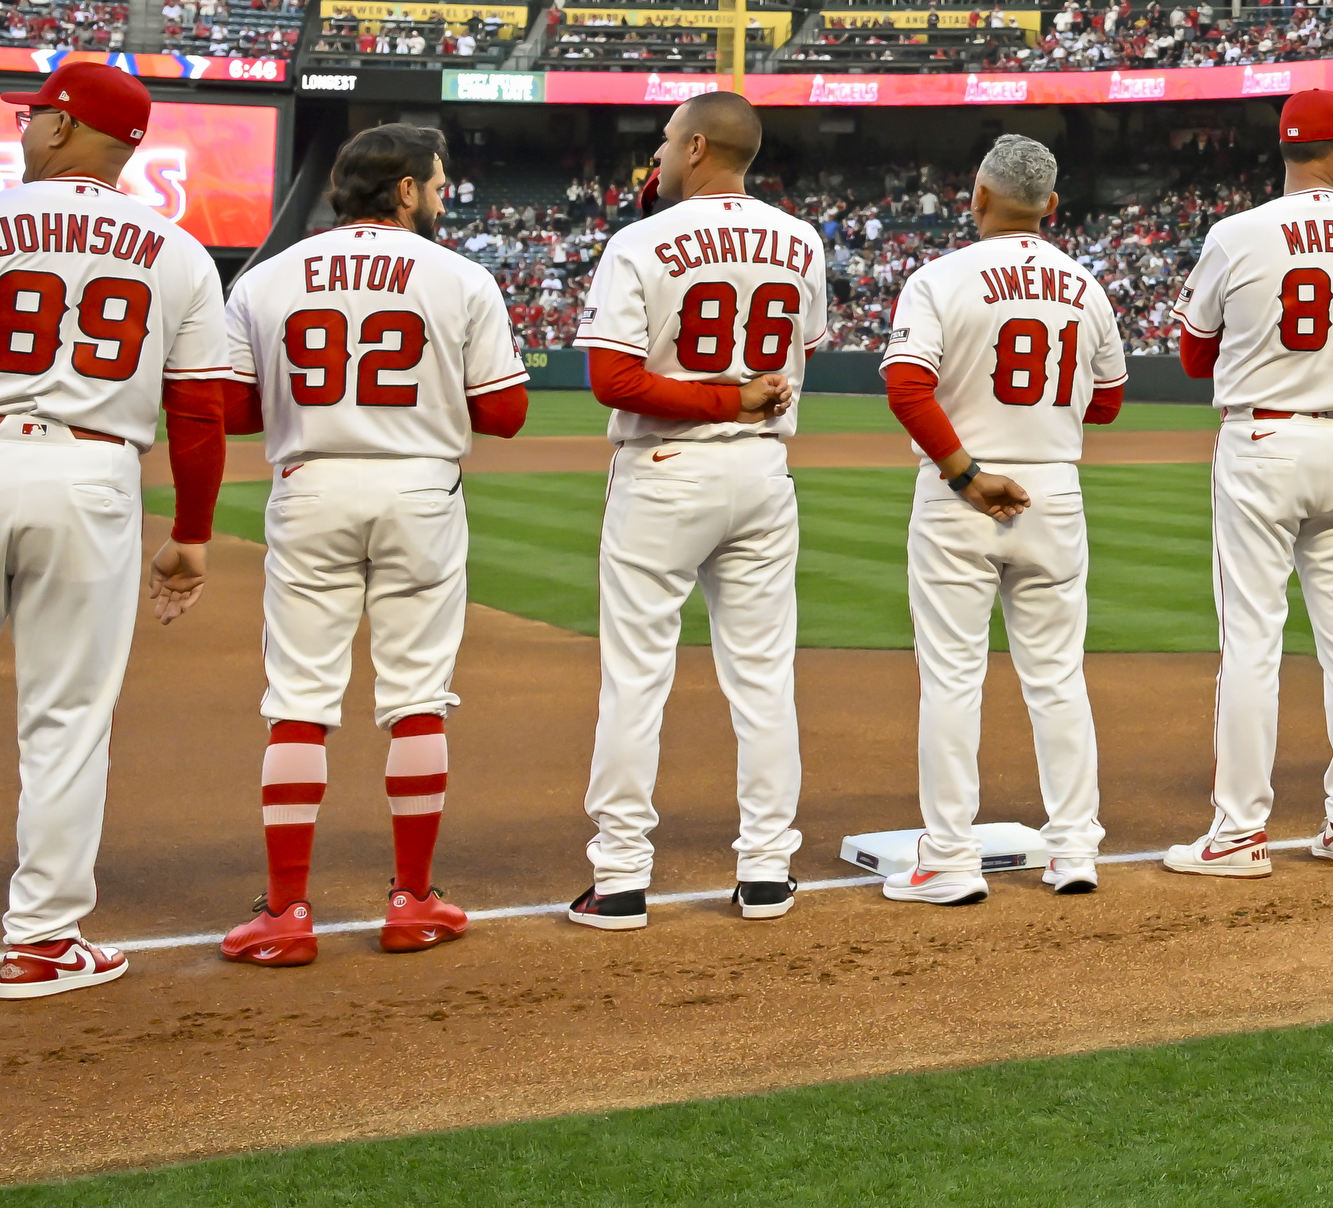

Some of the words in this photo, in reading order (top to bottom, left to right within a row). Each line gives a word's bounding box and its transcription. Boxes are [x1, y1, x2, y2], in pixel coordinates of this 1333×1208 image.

[302, 74, 357, 91] LONGEST
[810, 74, 878, 102] ANGELS
[965, 73, 1028, 101] ANGELS
[1108, 71, 1166, 100] ANGELS
[1242, 65, 1291, 94] ANGELS
[0, 212, 165, 269] JOHNSON
[655, 228, 814, 278] SCHATZLEY
[304, 255, 415, 294] EATON
[980, 256, 1087, 310] JIMÉNEZ
[0, 269, 152, 381] 89
[673, 281, 800, 373] 86
[282, 308, 429, 407] 92
[525, 353, 548, 368] 350
[990, 317, 1079, 407] 81
[1251, 848, 1269, 861] NI
